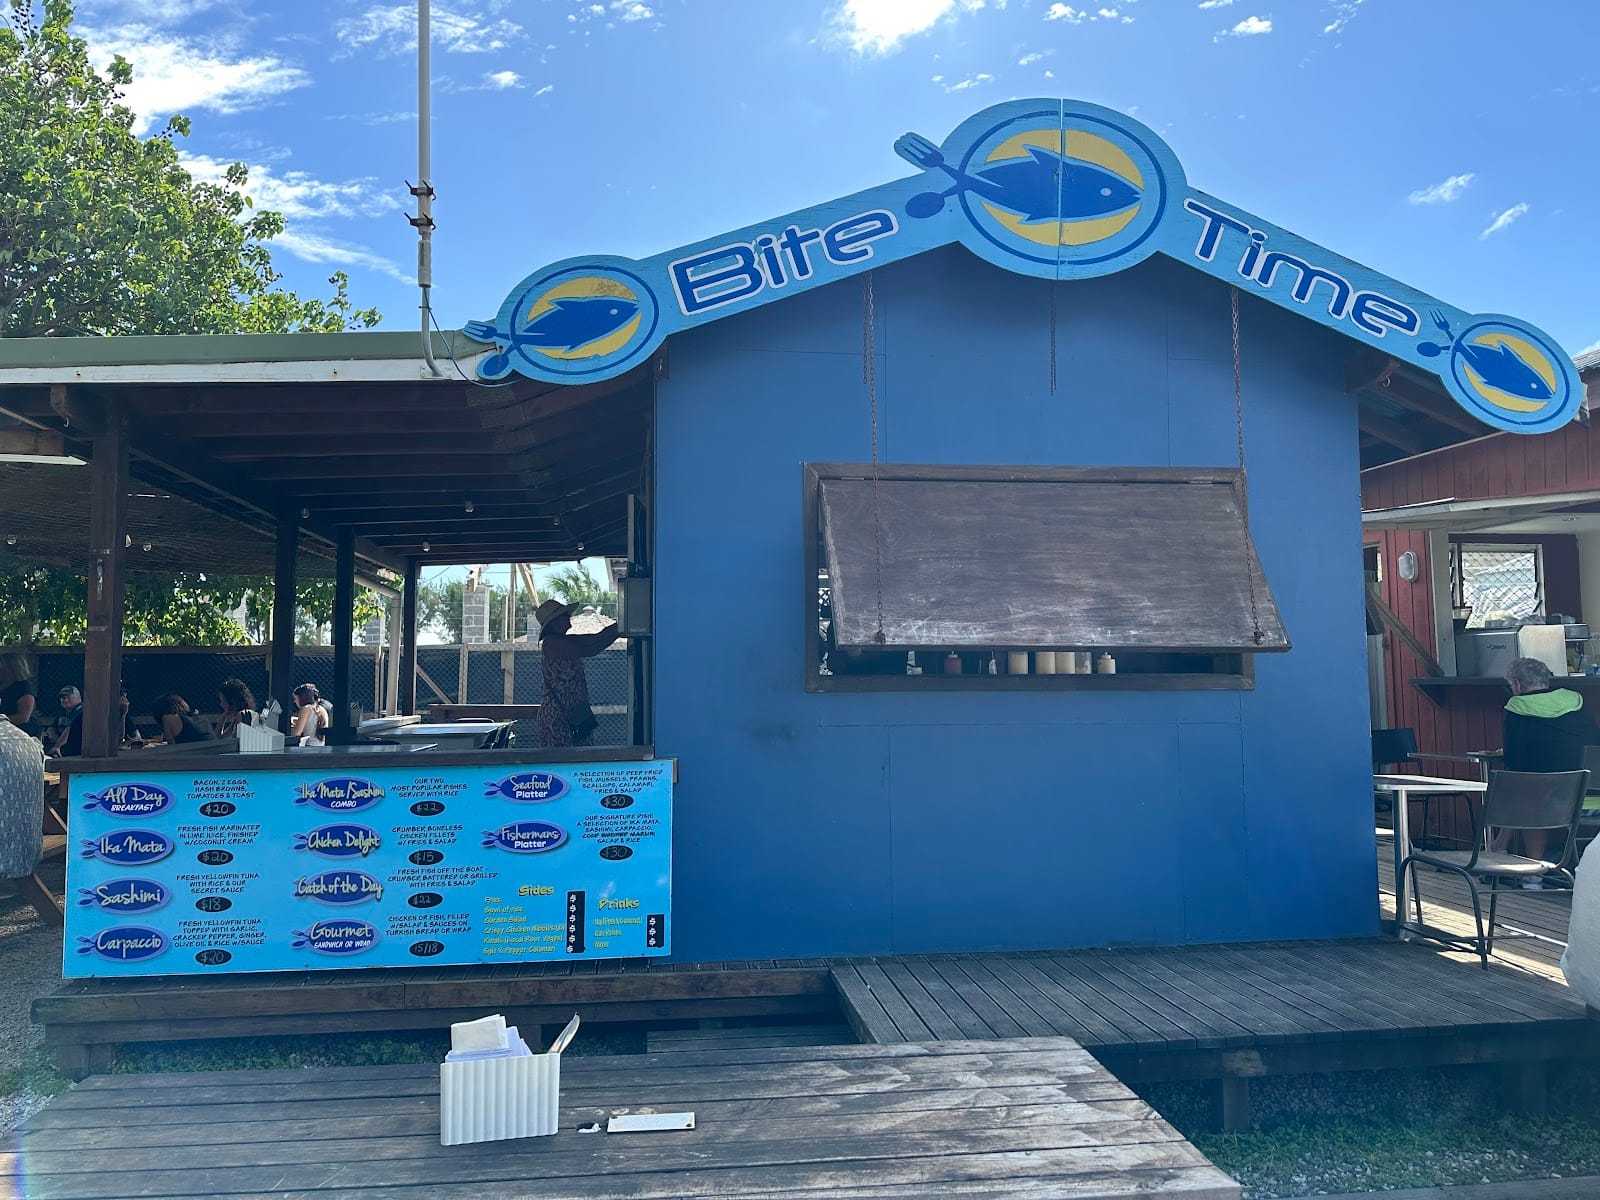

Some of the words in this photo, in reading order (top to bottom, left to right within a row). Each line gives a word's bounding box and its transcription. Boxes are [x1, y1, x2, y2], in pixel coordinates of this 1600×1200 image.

[668, 209, 899, 316] Bite
[1184, 198, 1421, 338] Time
[510, 774, 553, 791] Seafood
[302, 782, 317, 799] Ika
[317, 782, 345, 799] Mata
[515, 790, 548, 799] Platter
[103, 786, 127, 803] All
[130, 786, 165, 807] Day
[603, 796, 626, 807] $30
[110, 804, 155, 812] BREAKFAST
[204, 804, 229, 815] $20
[330, 800, 357, 808] COMBO
[500, 824, 560, 841] Fishermans
[100, 837, 122, 854] Ika
[123, 835, 166, 854] Mata
[308, 831, 342, 848] Chicken
[344, 830, 380, 854] Delight
[514, 840, 547, 849] Platter
[202, 851, 229, 862] $20
[414, 851, 434, 865] $15
[298, 876, 327, 894] Catch
[328, 877, 340, 894] of
[340, 874, 358, 893] the
[359, 875, 383, 899] Day
[518, 885, 554, 896] Sides
[96, 883, 161, 907] Sashimi
[569, 893, 577, 903] $
[200, 898, 221, 911] $18
[569, 904, 576, 913] $
[598, 898, 640, 910] Drinks
[484, 906, 501, 914] Bowl
[569, 914, 576, 923] $
[649, 917, 656, 926] $
[310, 920, 373, 940] Gourmet
[568, 924, 576, 933] $
[649, 928, 656, 936] $
[568, 934, 576, 943] $
[648, 937, 656, 946] $
[96, 930, 162, 959] Carpaccio
[314, 941, 343, 949] SANDWICH
[345, 940, 353, 948] OR
[414, 943, 438, 954] 15/18
[566, 944, 574, 953] $
[200, 951, 224, 964] $20
